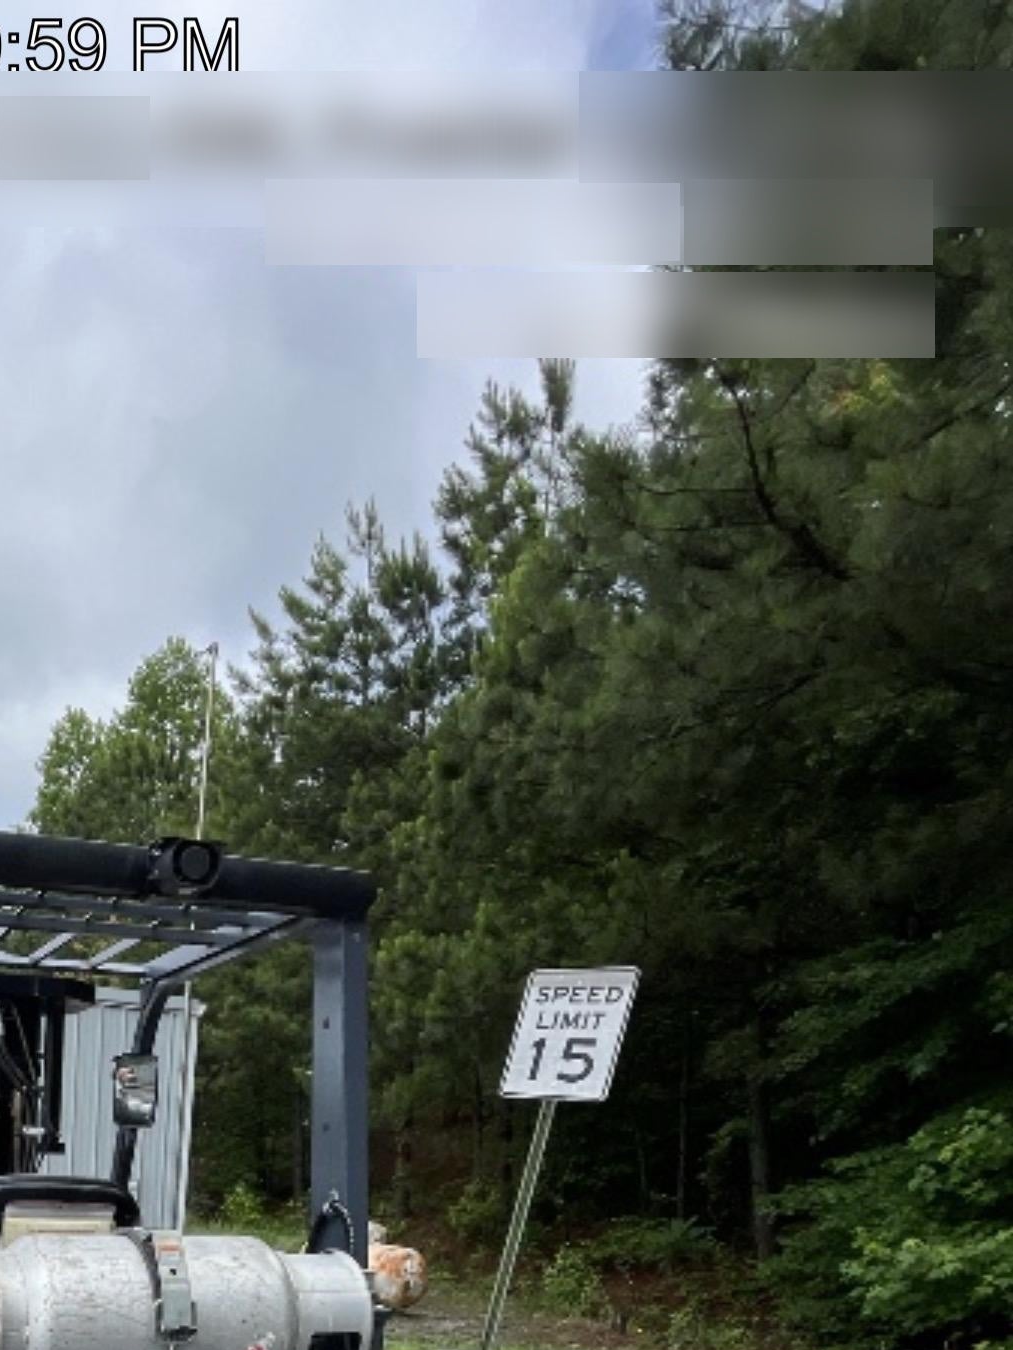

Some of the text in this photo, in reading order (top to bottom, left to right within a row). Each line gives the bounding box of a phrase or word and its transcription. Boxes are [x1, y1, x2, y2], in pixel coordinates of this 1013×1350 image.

[535, 985, 624, 1003] SPEED
[535, 1011, 606, 1030] LIMIT
[527, 1037, 597, 1083] 15
